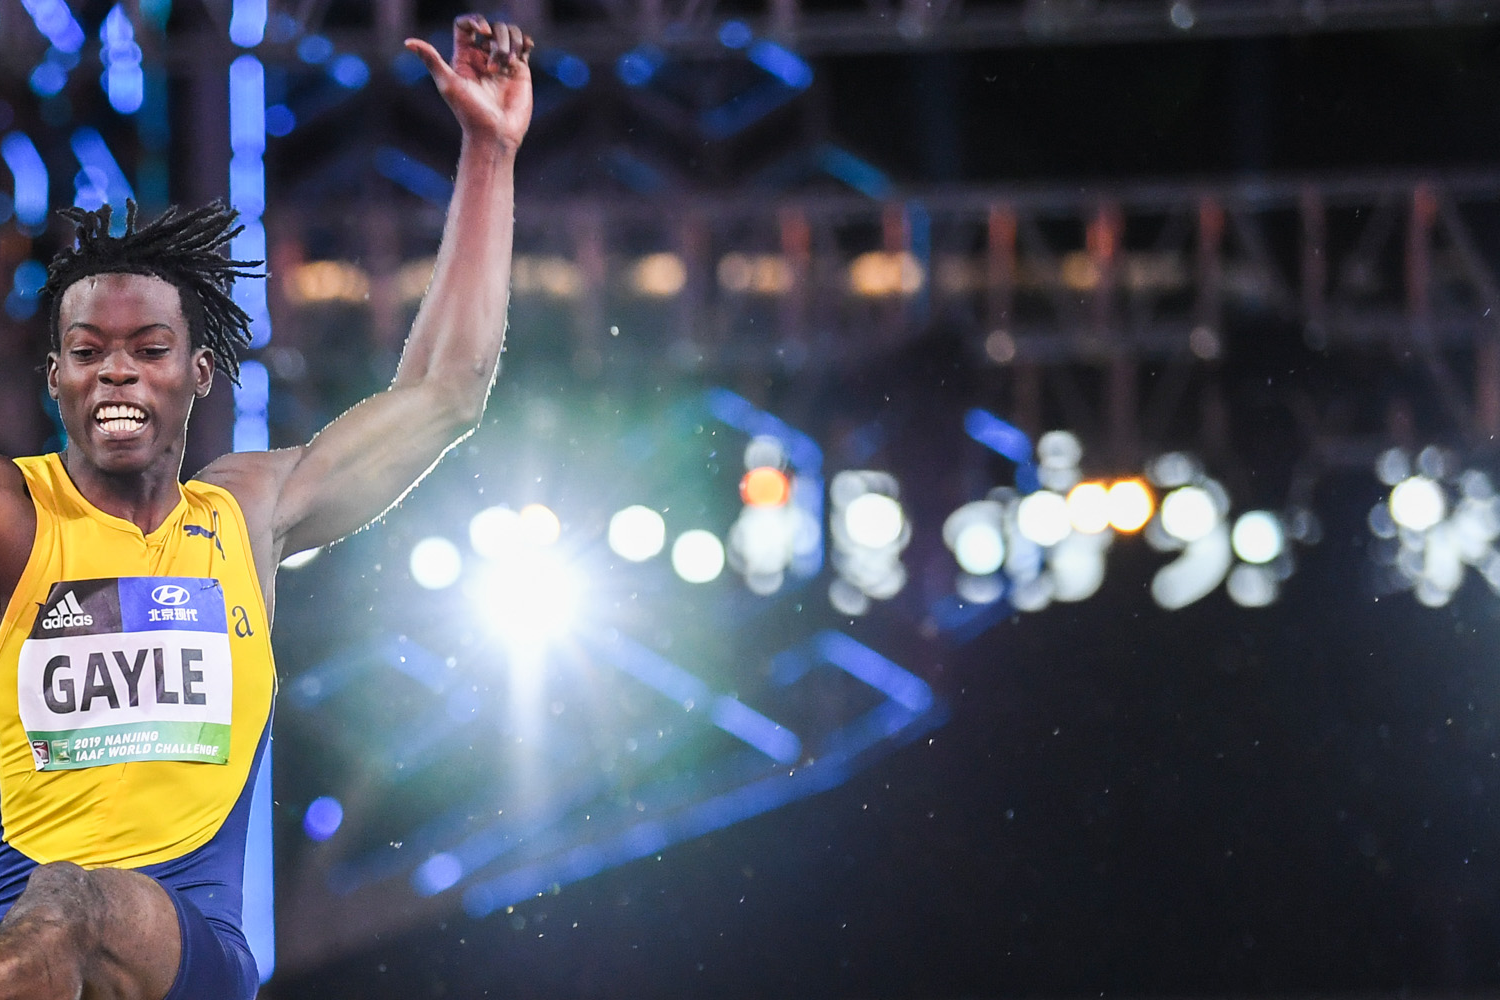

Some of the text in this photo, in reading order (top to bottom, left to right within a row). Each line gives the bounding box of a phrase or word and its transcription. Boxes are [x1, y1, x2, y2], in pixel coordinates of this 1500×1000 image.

[42, 613, 94, 630] adidas
[148, 607, 199, 622] 北京现代
[42, 647, 207, 714] GAYLE
[73, 736, 102, 750] 2019
[104, 731, 159, 746] NANJING
[75, 743, 219, 762] IAAF WORLD CHALLENGE
